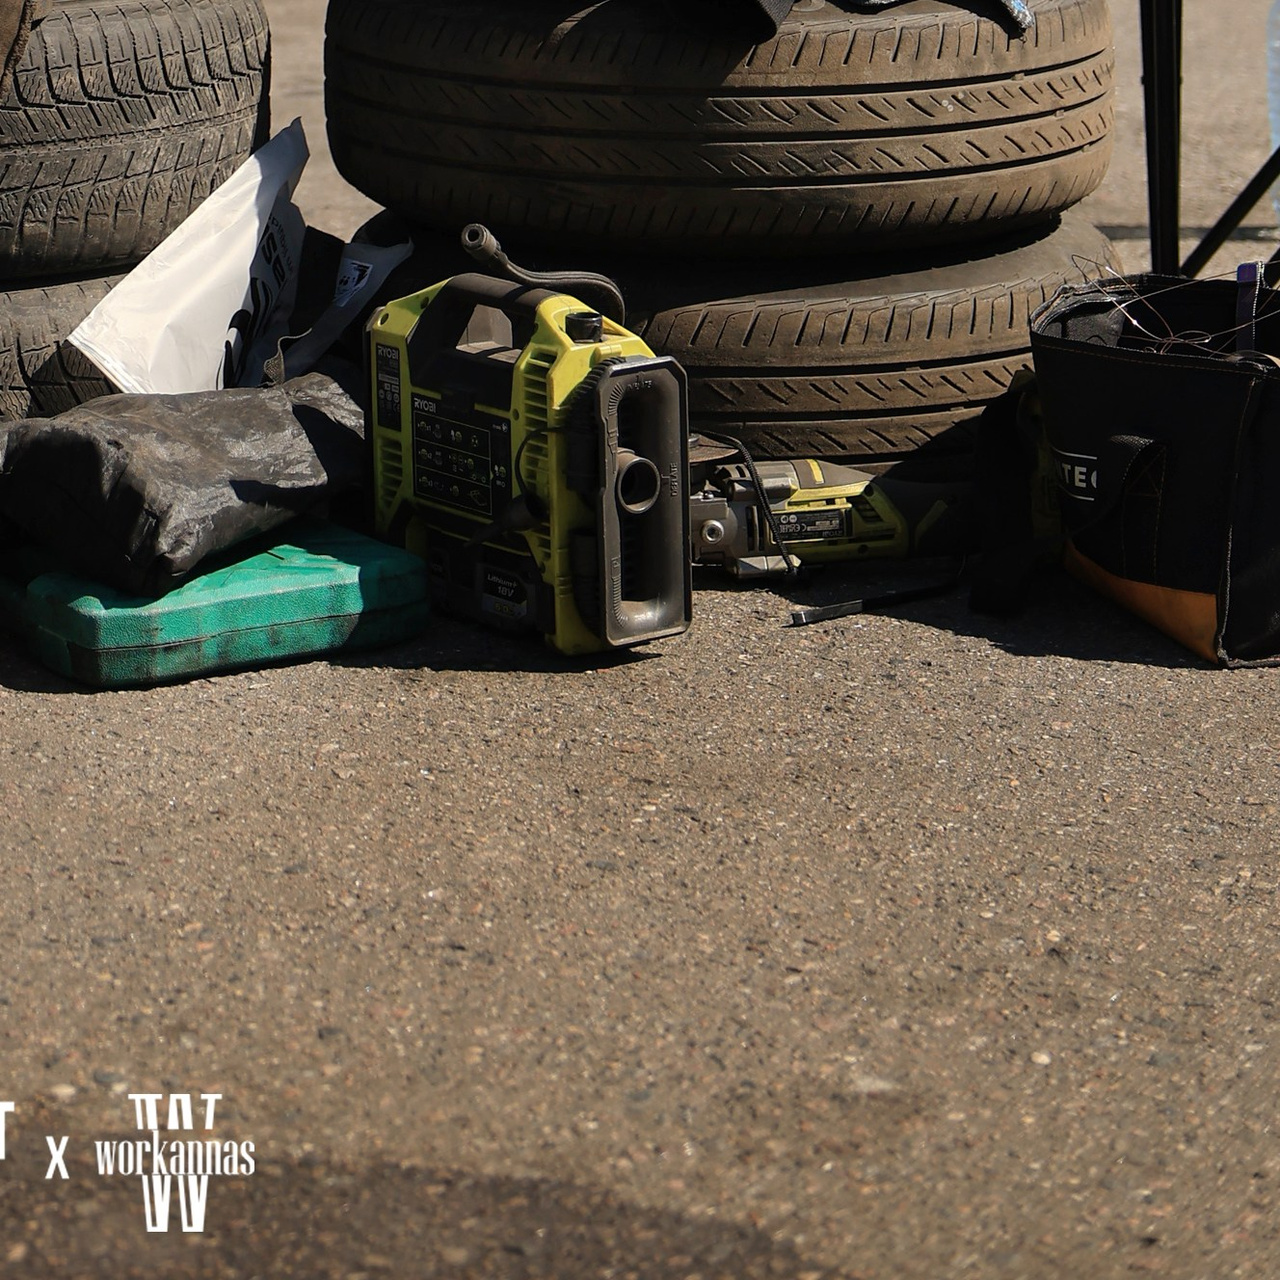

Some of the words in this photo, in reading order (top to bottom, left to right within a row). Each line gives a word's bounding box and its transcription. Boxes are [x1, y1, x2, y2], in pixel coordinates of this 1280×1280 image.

[377, 344, 399, 360] RYOBI
[413, 397, 437, 414] RYOBI
[497, 586, 515, 597] 18V
